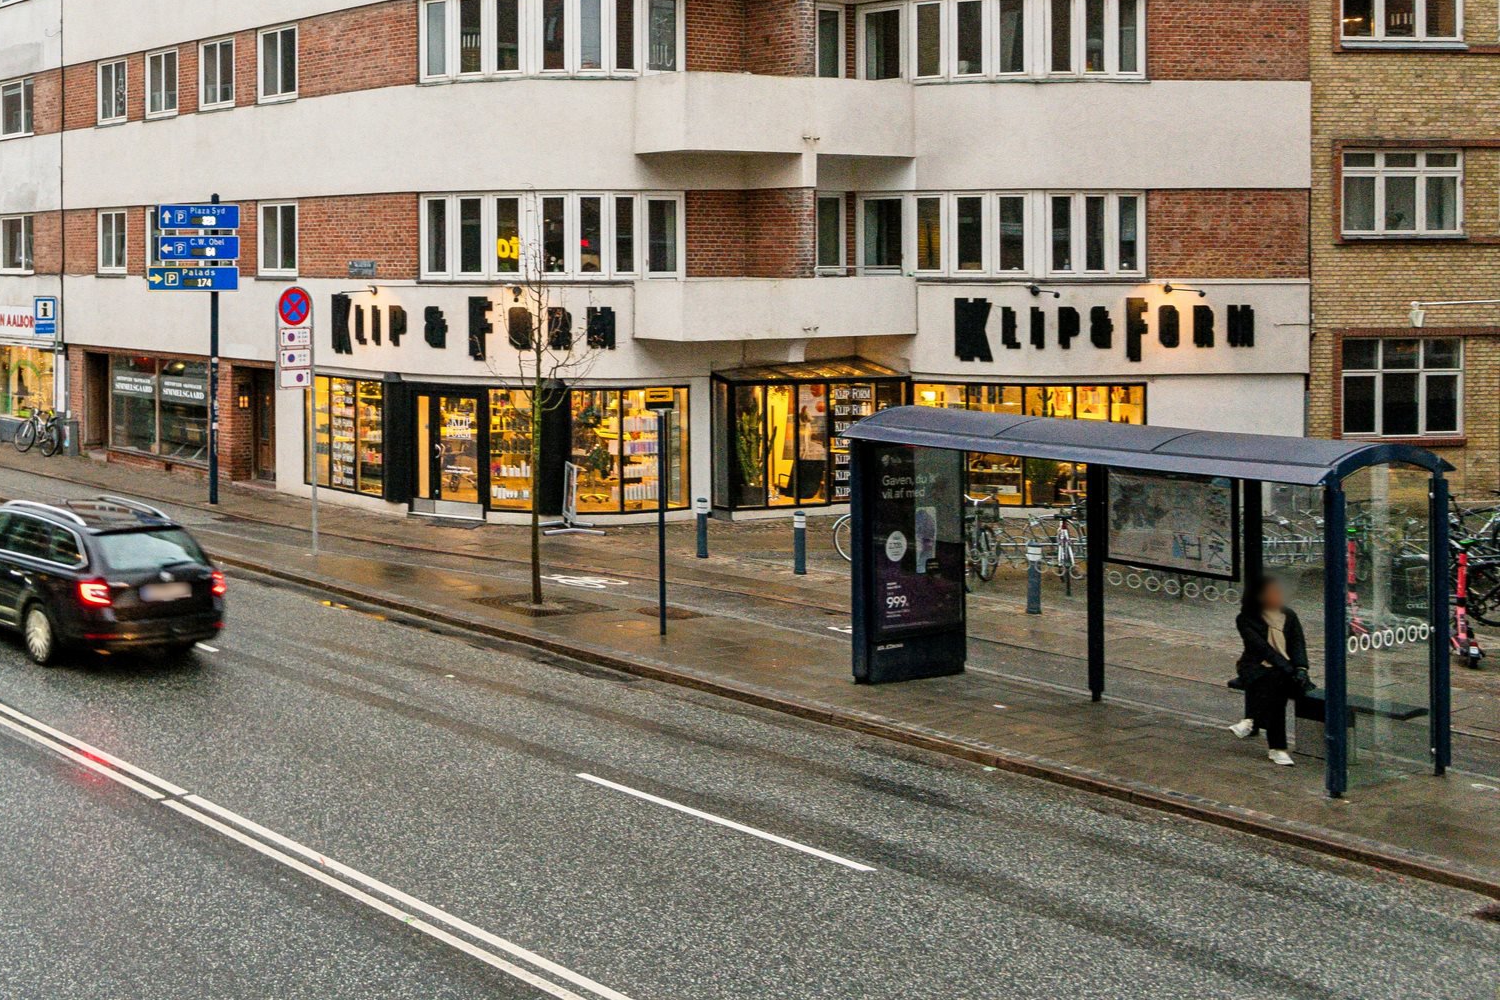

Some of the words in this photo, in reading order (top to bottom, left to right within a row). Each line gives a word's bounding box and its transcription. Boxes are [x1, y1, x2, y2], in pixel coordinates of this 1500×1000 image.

[190, 207, 210, 215] Plaza
[212, 207, 226, 216] Syd
[190, 238, 207, 247] C.W.
[209, 238, 225, 247] Obel
[182, 268, 216, 277] Palads
[197, 278, 213, 288] 174
[6, 314, 35, 328] AALBOR
[882, 475, 914, 487] Gaven,
[906, 486, 925, 499] med
